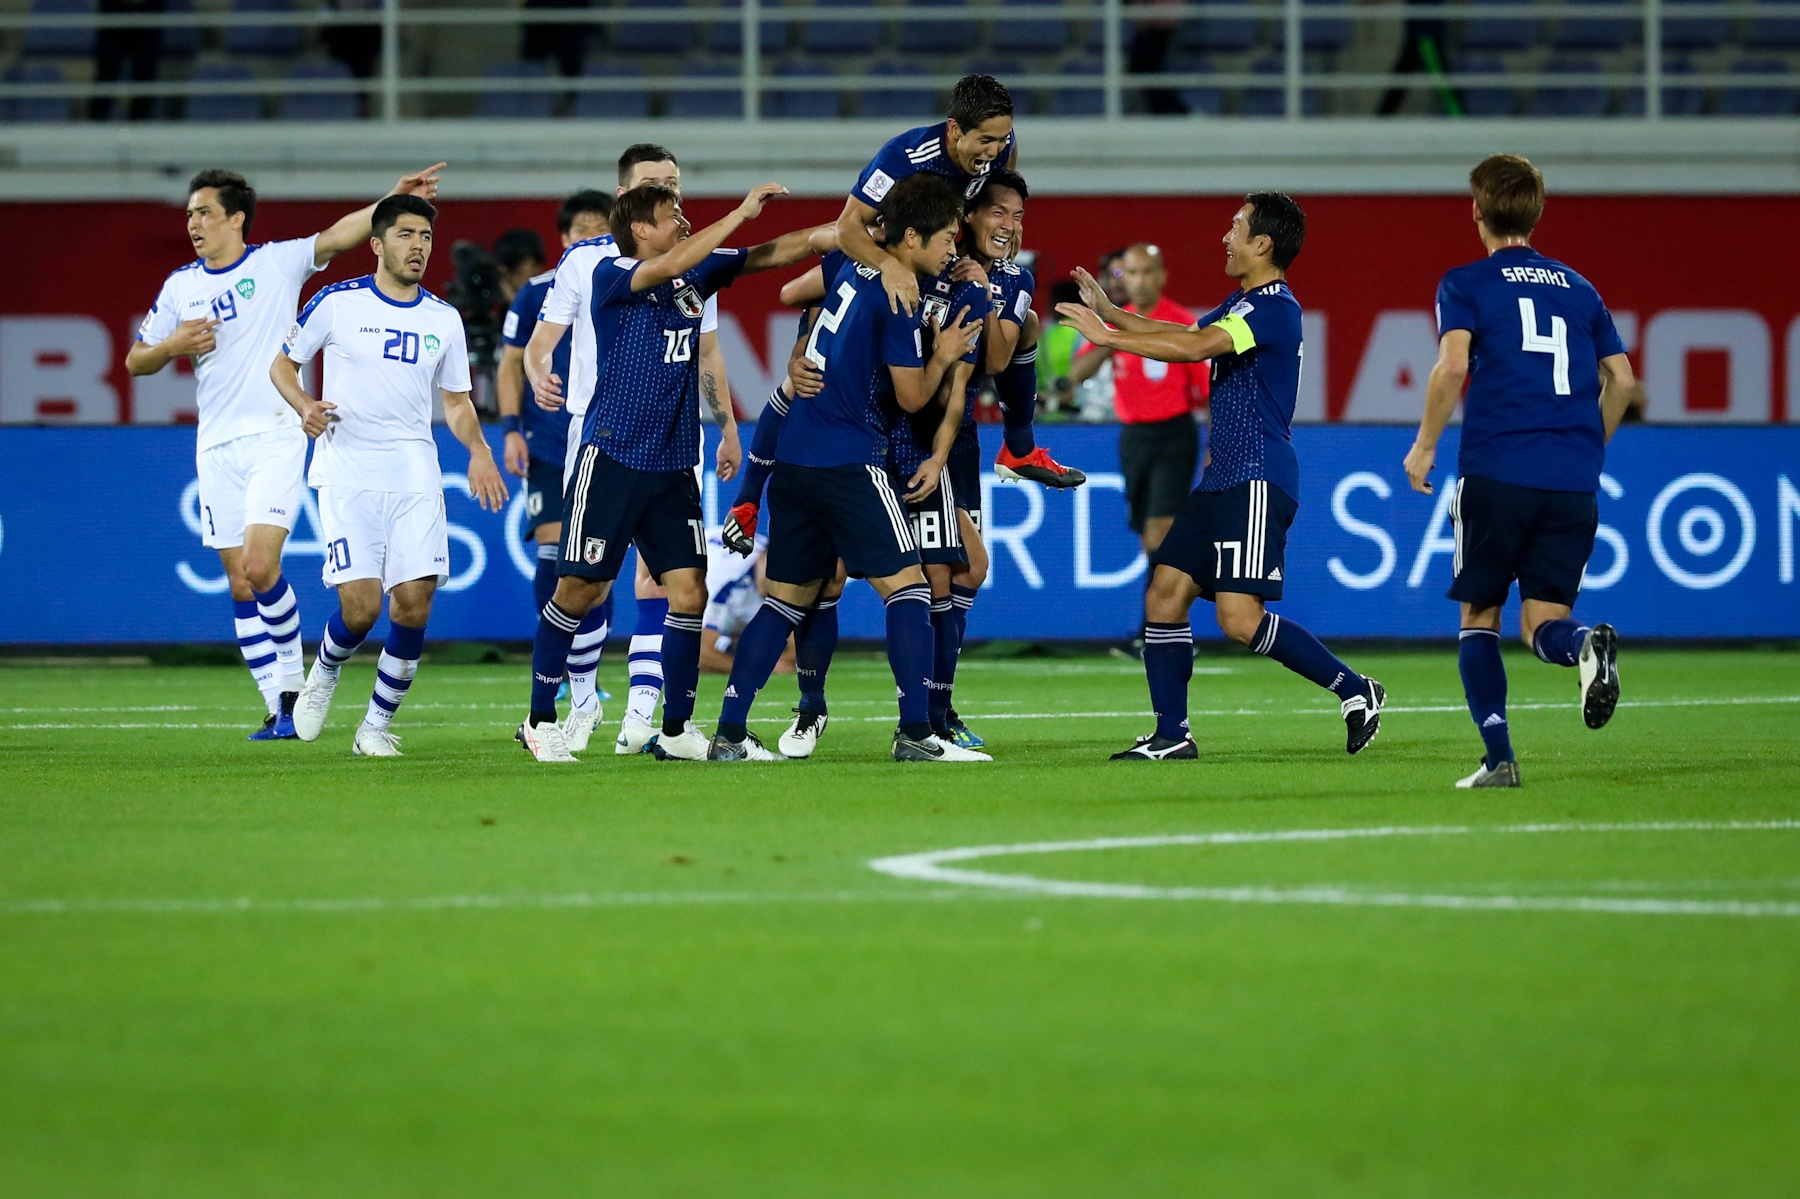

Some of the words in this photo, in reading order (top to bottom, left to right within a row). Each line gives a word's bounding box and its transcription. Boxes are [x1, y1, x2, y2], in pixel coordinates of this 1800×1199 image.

[238, 281, 254, 293] UFA
[1501, 266, 1570, 288] SASAKI
[189, 300, 205, 309] JAKO
[210, 289, 238, 322] 19
[358, 326, 380, 334] JAKO
[804, 280, 858, 372] 2
[383, 328, 419, 364] 20
[425, 337, 440, 349] UFA
[663, 327, 693, 363] 10
[1518, 297, 1571, 395] 4
[269, 506, 286, 515] JAKO
[1213, 541, 1242, 579] 17
[638, 689, 657, 700] JAKO
